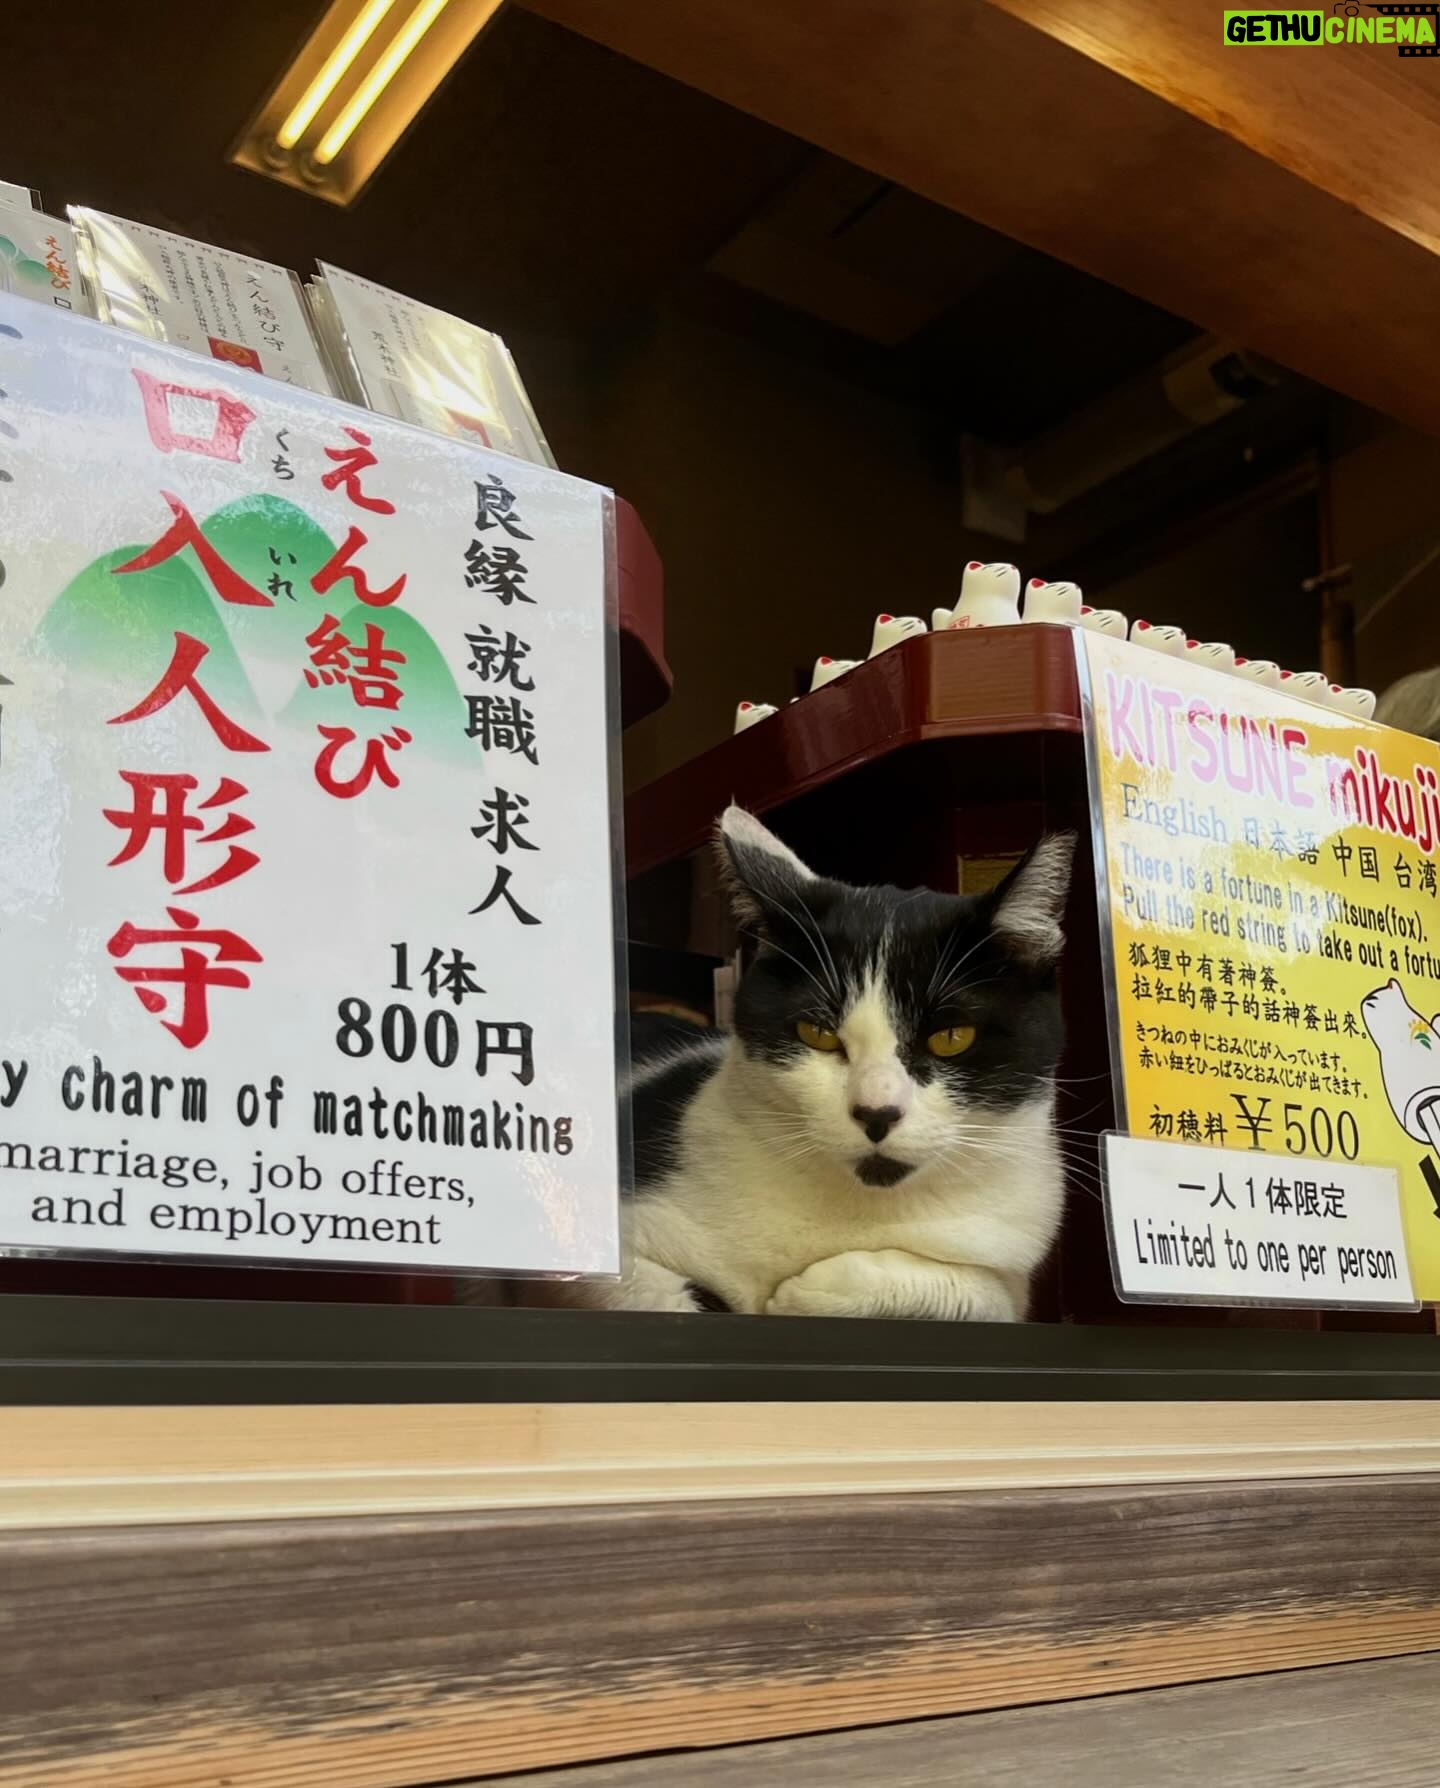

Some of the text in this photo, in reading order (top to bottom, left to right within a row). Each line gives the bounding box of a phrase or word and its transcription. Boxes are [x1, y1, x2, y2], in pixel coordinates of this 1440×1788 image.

[268, 547, 297, 602] いれ
[303, 426, 412, 799] えん結び
[463, 473, 543, 925] 良縁 就職 求人
[1106, 672, 1440, 852] KITSUNE mikuji
[1120, 783, 1437, 898] English 日本語 中国 台湾
[1120, 841, 1428, 944] There is a fortune in a Kitsune(fox).
[1122, 882, 1158, 923] Pull
[1166, 895, 1195, 930] the
[1202, 905, 1230, 937] red
[1237, 911, 1288, 953] string
[1294, 922, 1311, 954] to
[1318, 928, 1353, 963] take
[1359, 941, 1385, 969] out
[1390, 949, 1399, 972] a
[390, 941, 487, 1005] 1体
[336, 997, 535, 1086] 800円
[61, 1055, 207, 1122] charm
[237, 1075, 284, 1129] of
[313, 1086, 573, 1155] matchmaking
[0, 1139, 474, 1207] marriage, job offers,
[31, 1188, 442, 1244] and employment
[1133, 1218, 1398, 1284] Limited to one per person
